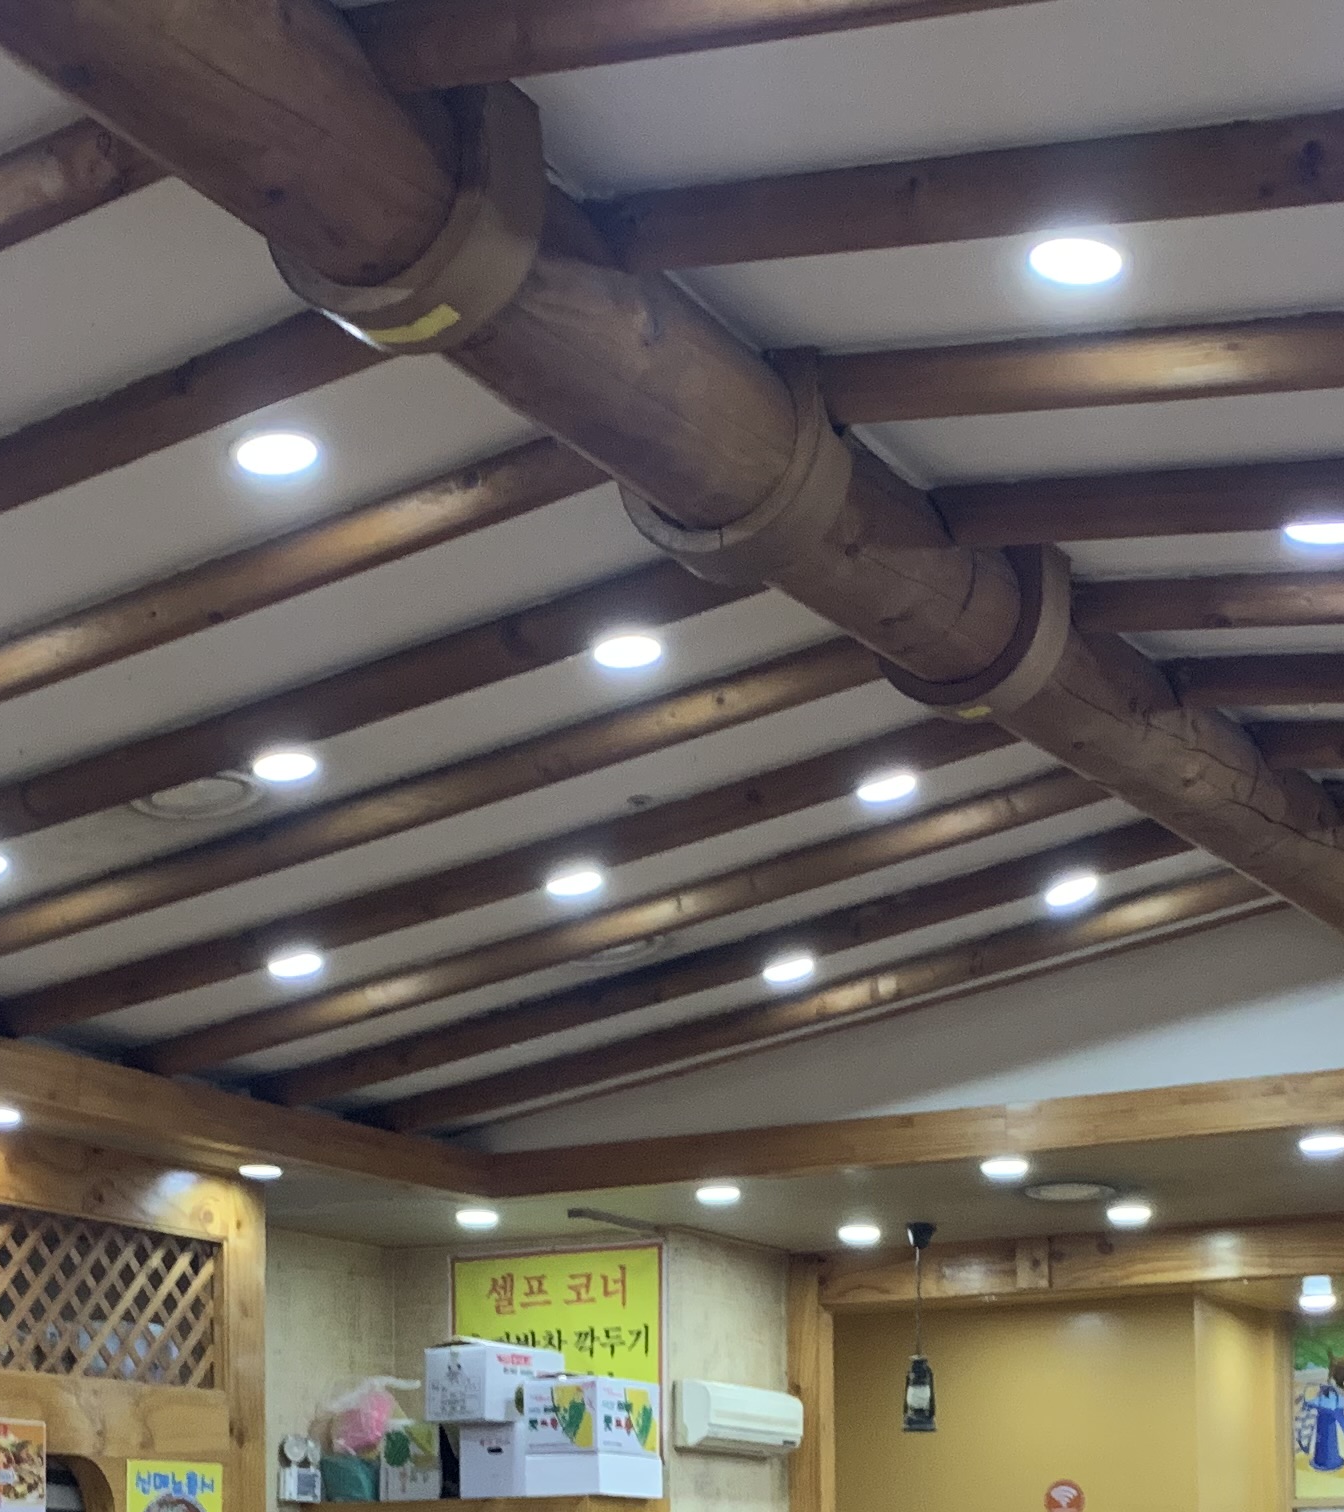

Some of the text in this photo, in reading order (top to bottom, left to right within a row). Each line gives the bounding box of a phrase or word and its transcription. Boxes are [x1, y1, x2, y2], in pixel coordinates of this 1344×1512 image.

[487, 1264, 627, 1315] 셀프 코너
[574, 1323, 650, 1358] 깍두기
